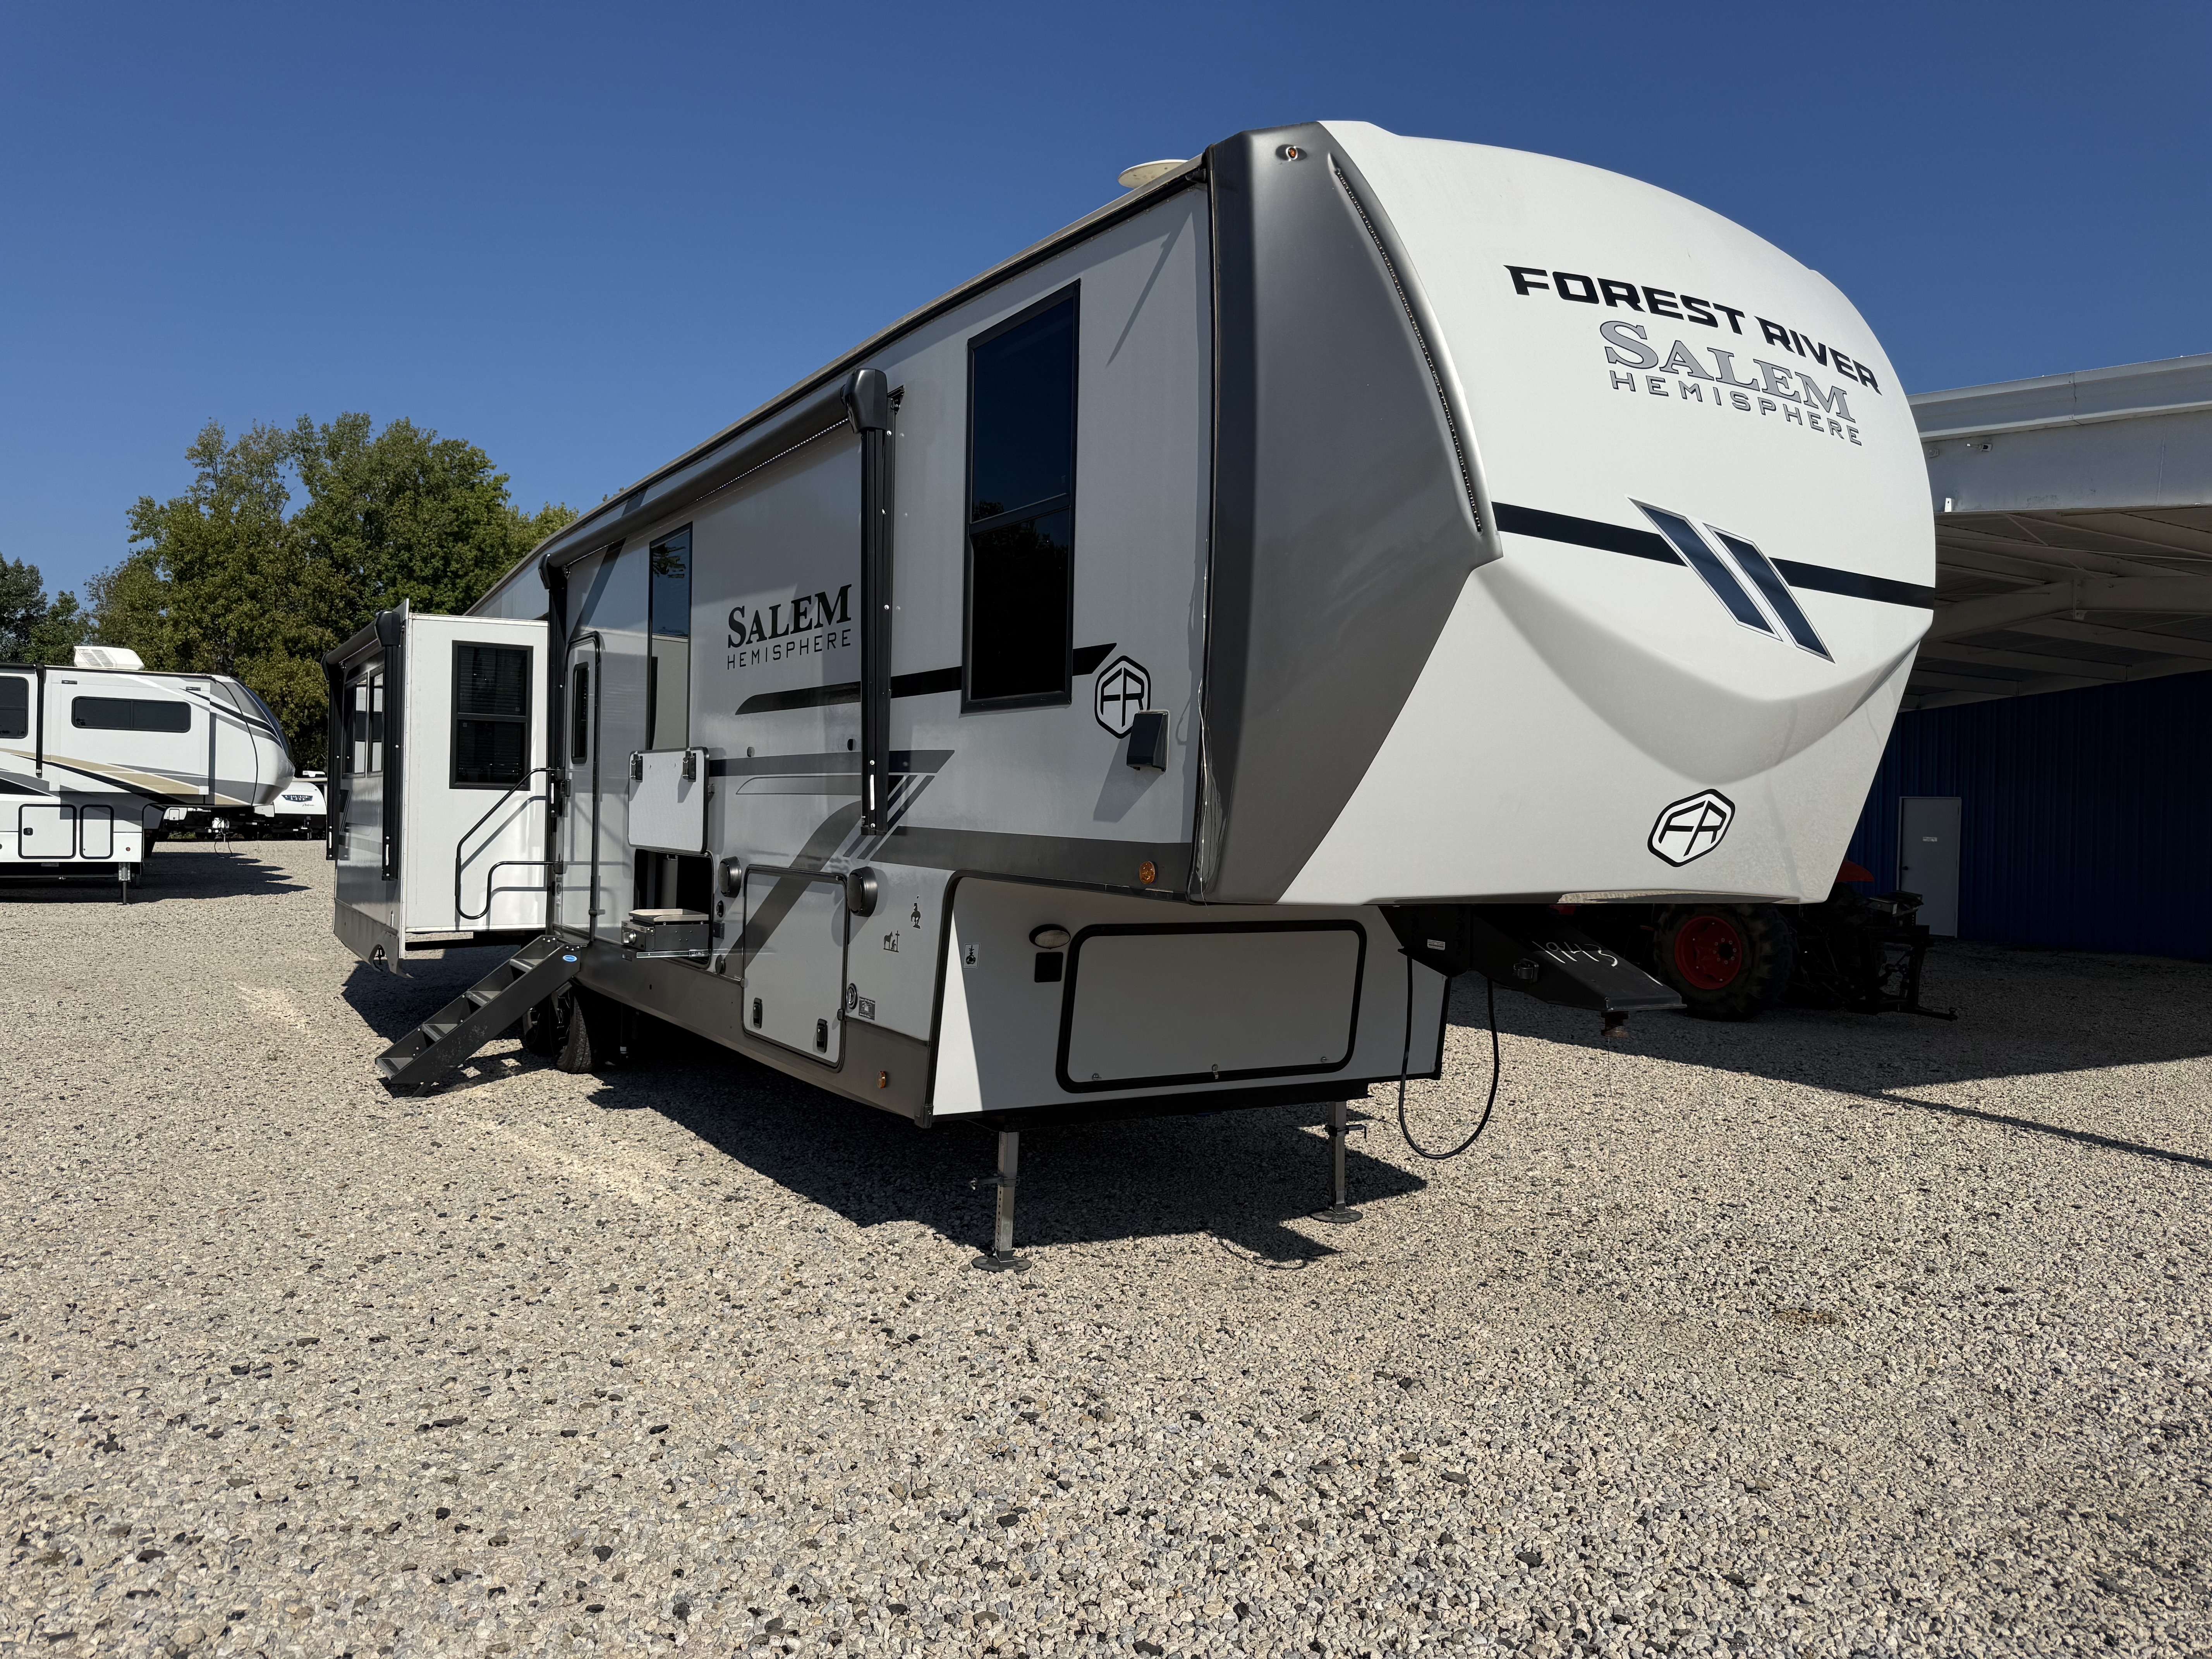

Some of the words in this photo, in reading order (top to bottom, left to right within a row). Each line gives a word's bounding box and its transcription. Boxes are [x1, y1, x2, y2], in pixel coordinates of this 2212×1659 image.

[1503, 265, 1745, 335] FOREST
[1754, 315, 1882, 395] RIVER
[1600, 321, 1856, 423] SALEM
[1609, 370, 1862, 446] HEMISPHERE
[727, 628, 851, 670] HEMISPHERE
[728, 584, 852, 648] SALEM
[1532, 941, 1618, 967] 1943
